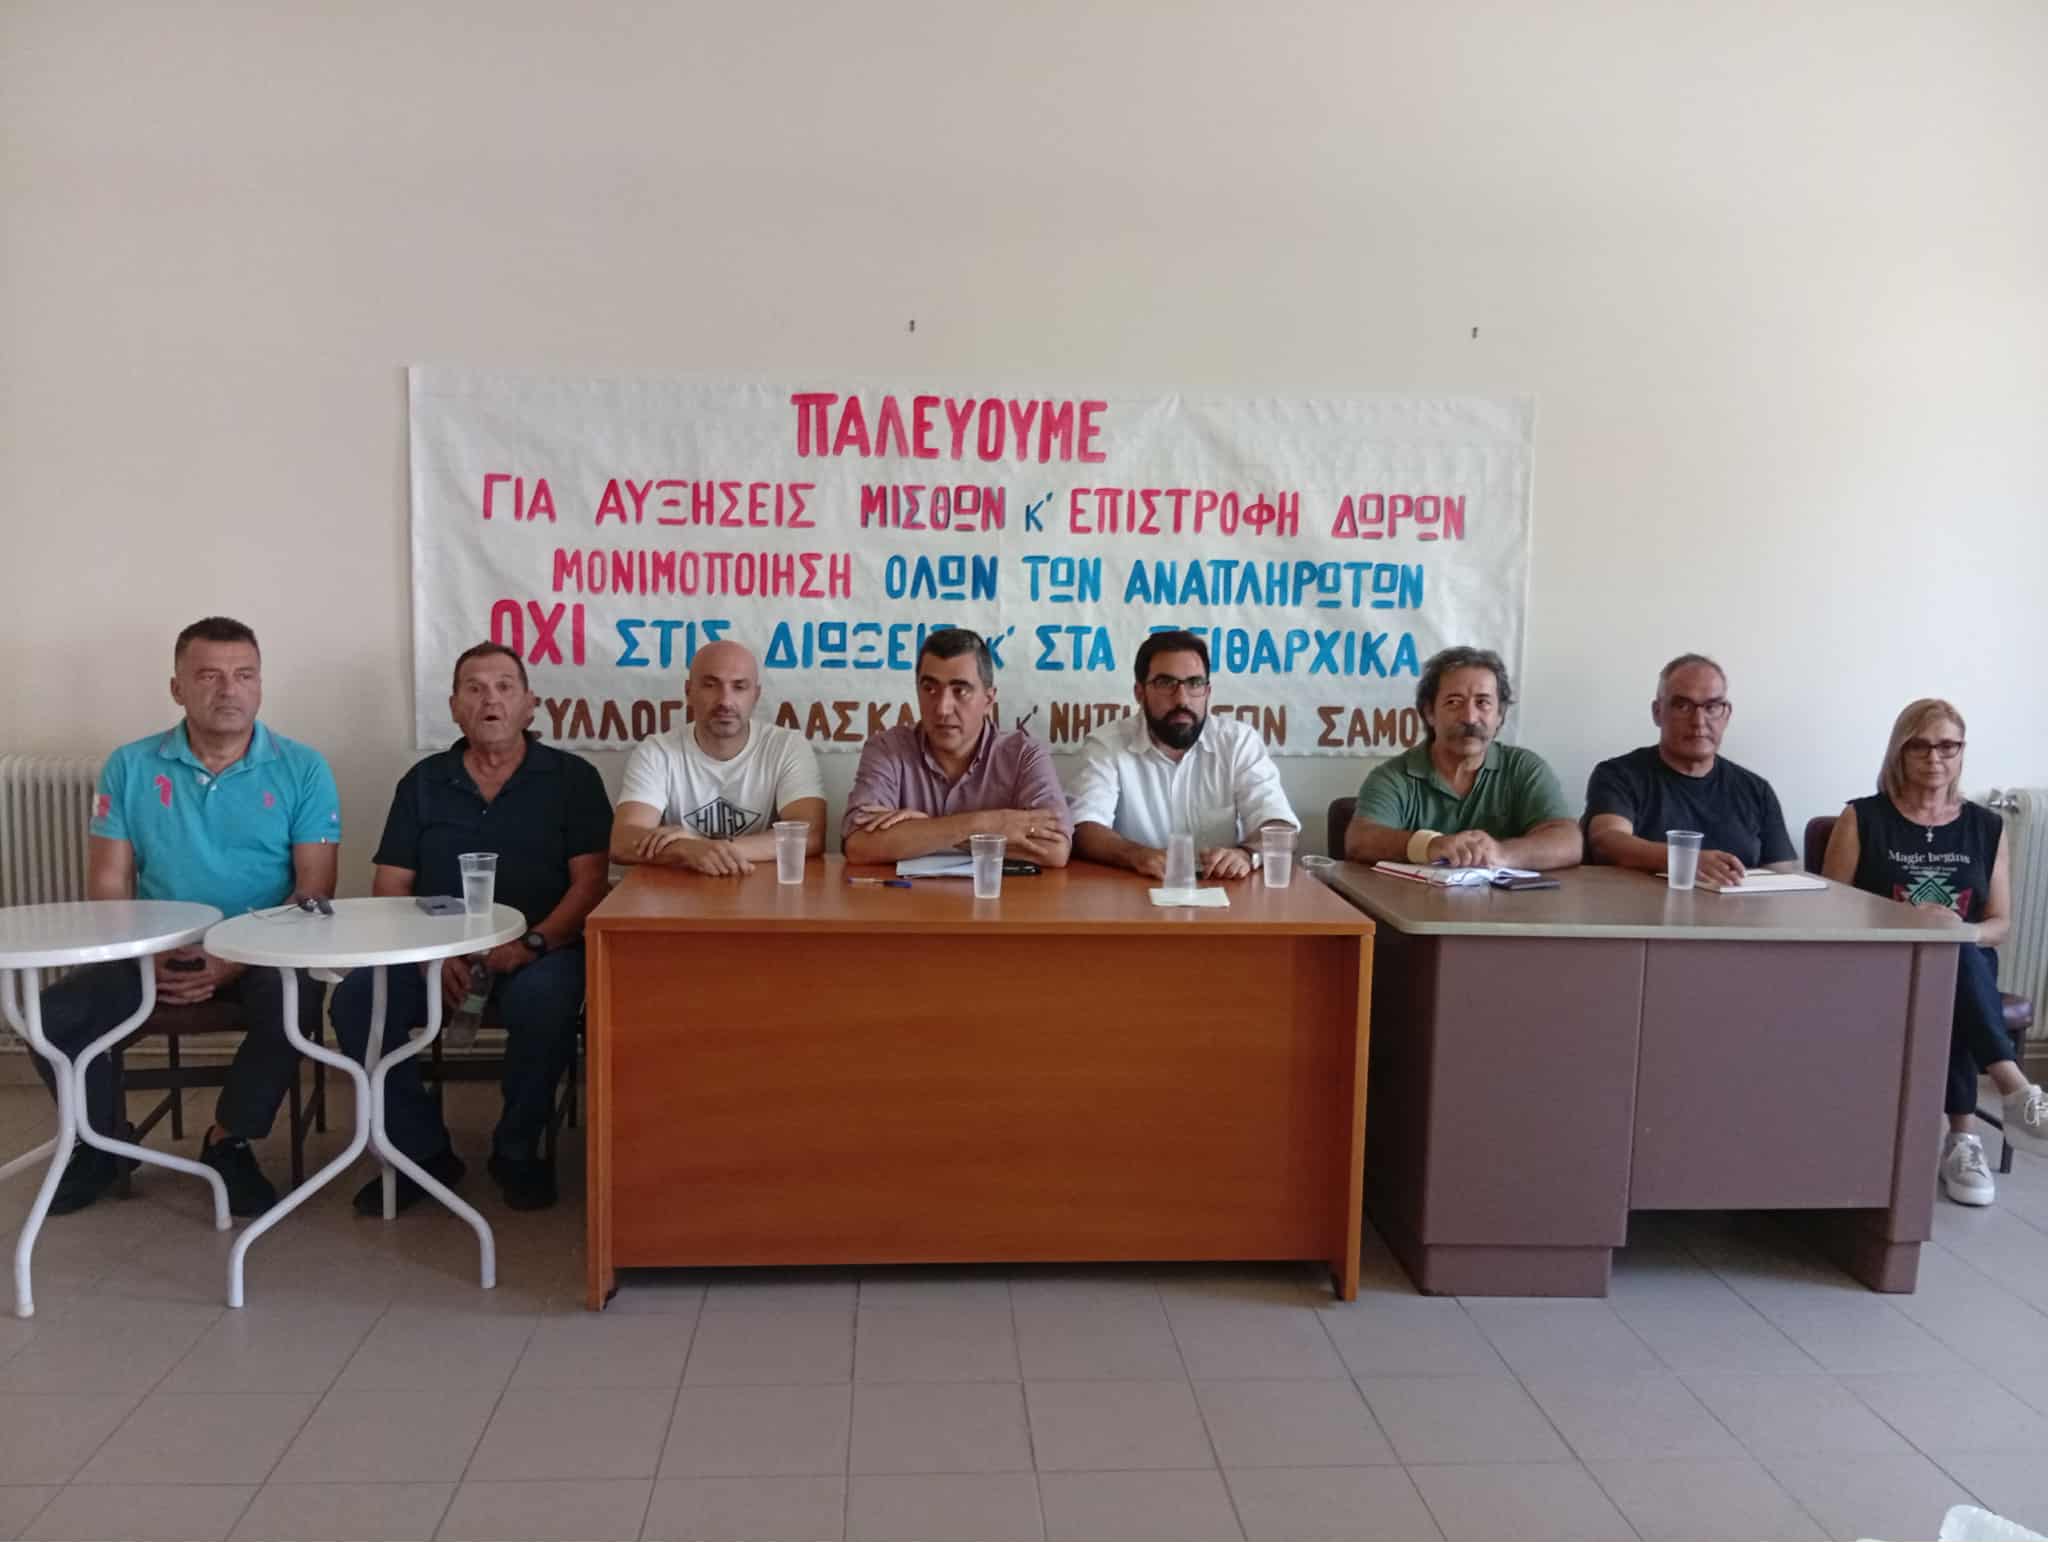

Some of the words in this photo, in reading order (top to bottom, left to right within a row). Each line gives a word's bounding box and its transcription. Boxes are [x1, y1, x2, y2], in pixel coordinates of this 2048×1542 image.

[790, 392, 1108, 464] ΠΑΛΕΥΟΥΜΕ
[482, 472, 557, 523] ΓΙΑ
[595, 478, 817, 530] ΑΥΞΗΣΕΙΣ
[860, 484, 1006, 532] ΜΙΣΘΩΝ
[1069, 486, 1300, 537] ΕΠΙΣΤΡΟΦΗ
[1331, 493, 1466, 541] ΔΩΡΩΝ
[552, 548, 852, 599] ΜΟΝΙΜΟΠΟΙΗΣΗ
[884, 553, 999, 602] ΟΛΩΝ
[1022, 554, 1103, 603] ΤΩΝ
[1123, 558, 1425, 609] ΑΝΑΠΛΗΡΩΤΩΝ
[489, 598, 586, 667] ΟΧΙ
[763, 620, 957, 671] ΔΙΩΞΕΙ
[1035, 623, 1117, 672] ΣΤΑ
[1317, 705, 1419, 747] ΣΑΜΟ
[1887, 849, 1926, 864] Magic
